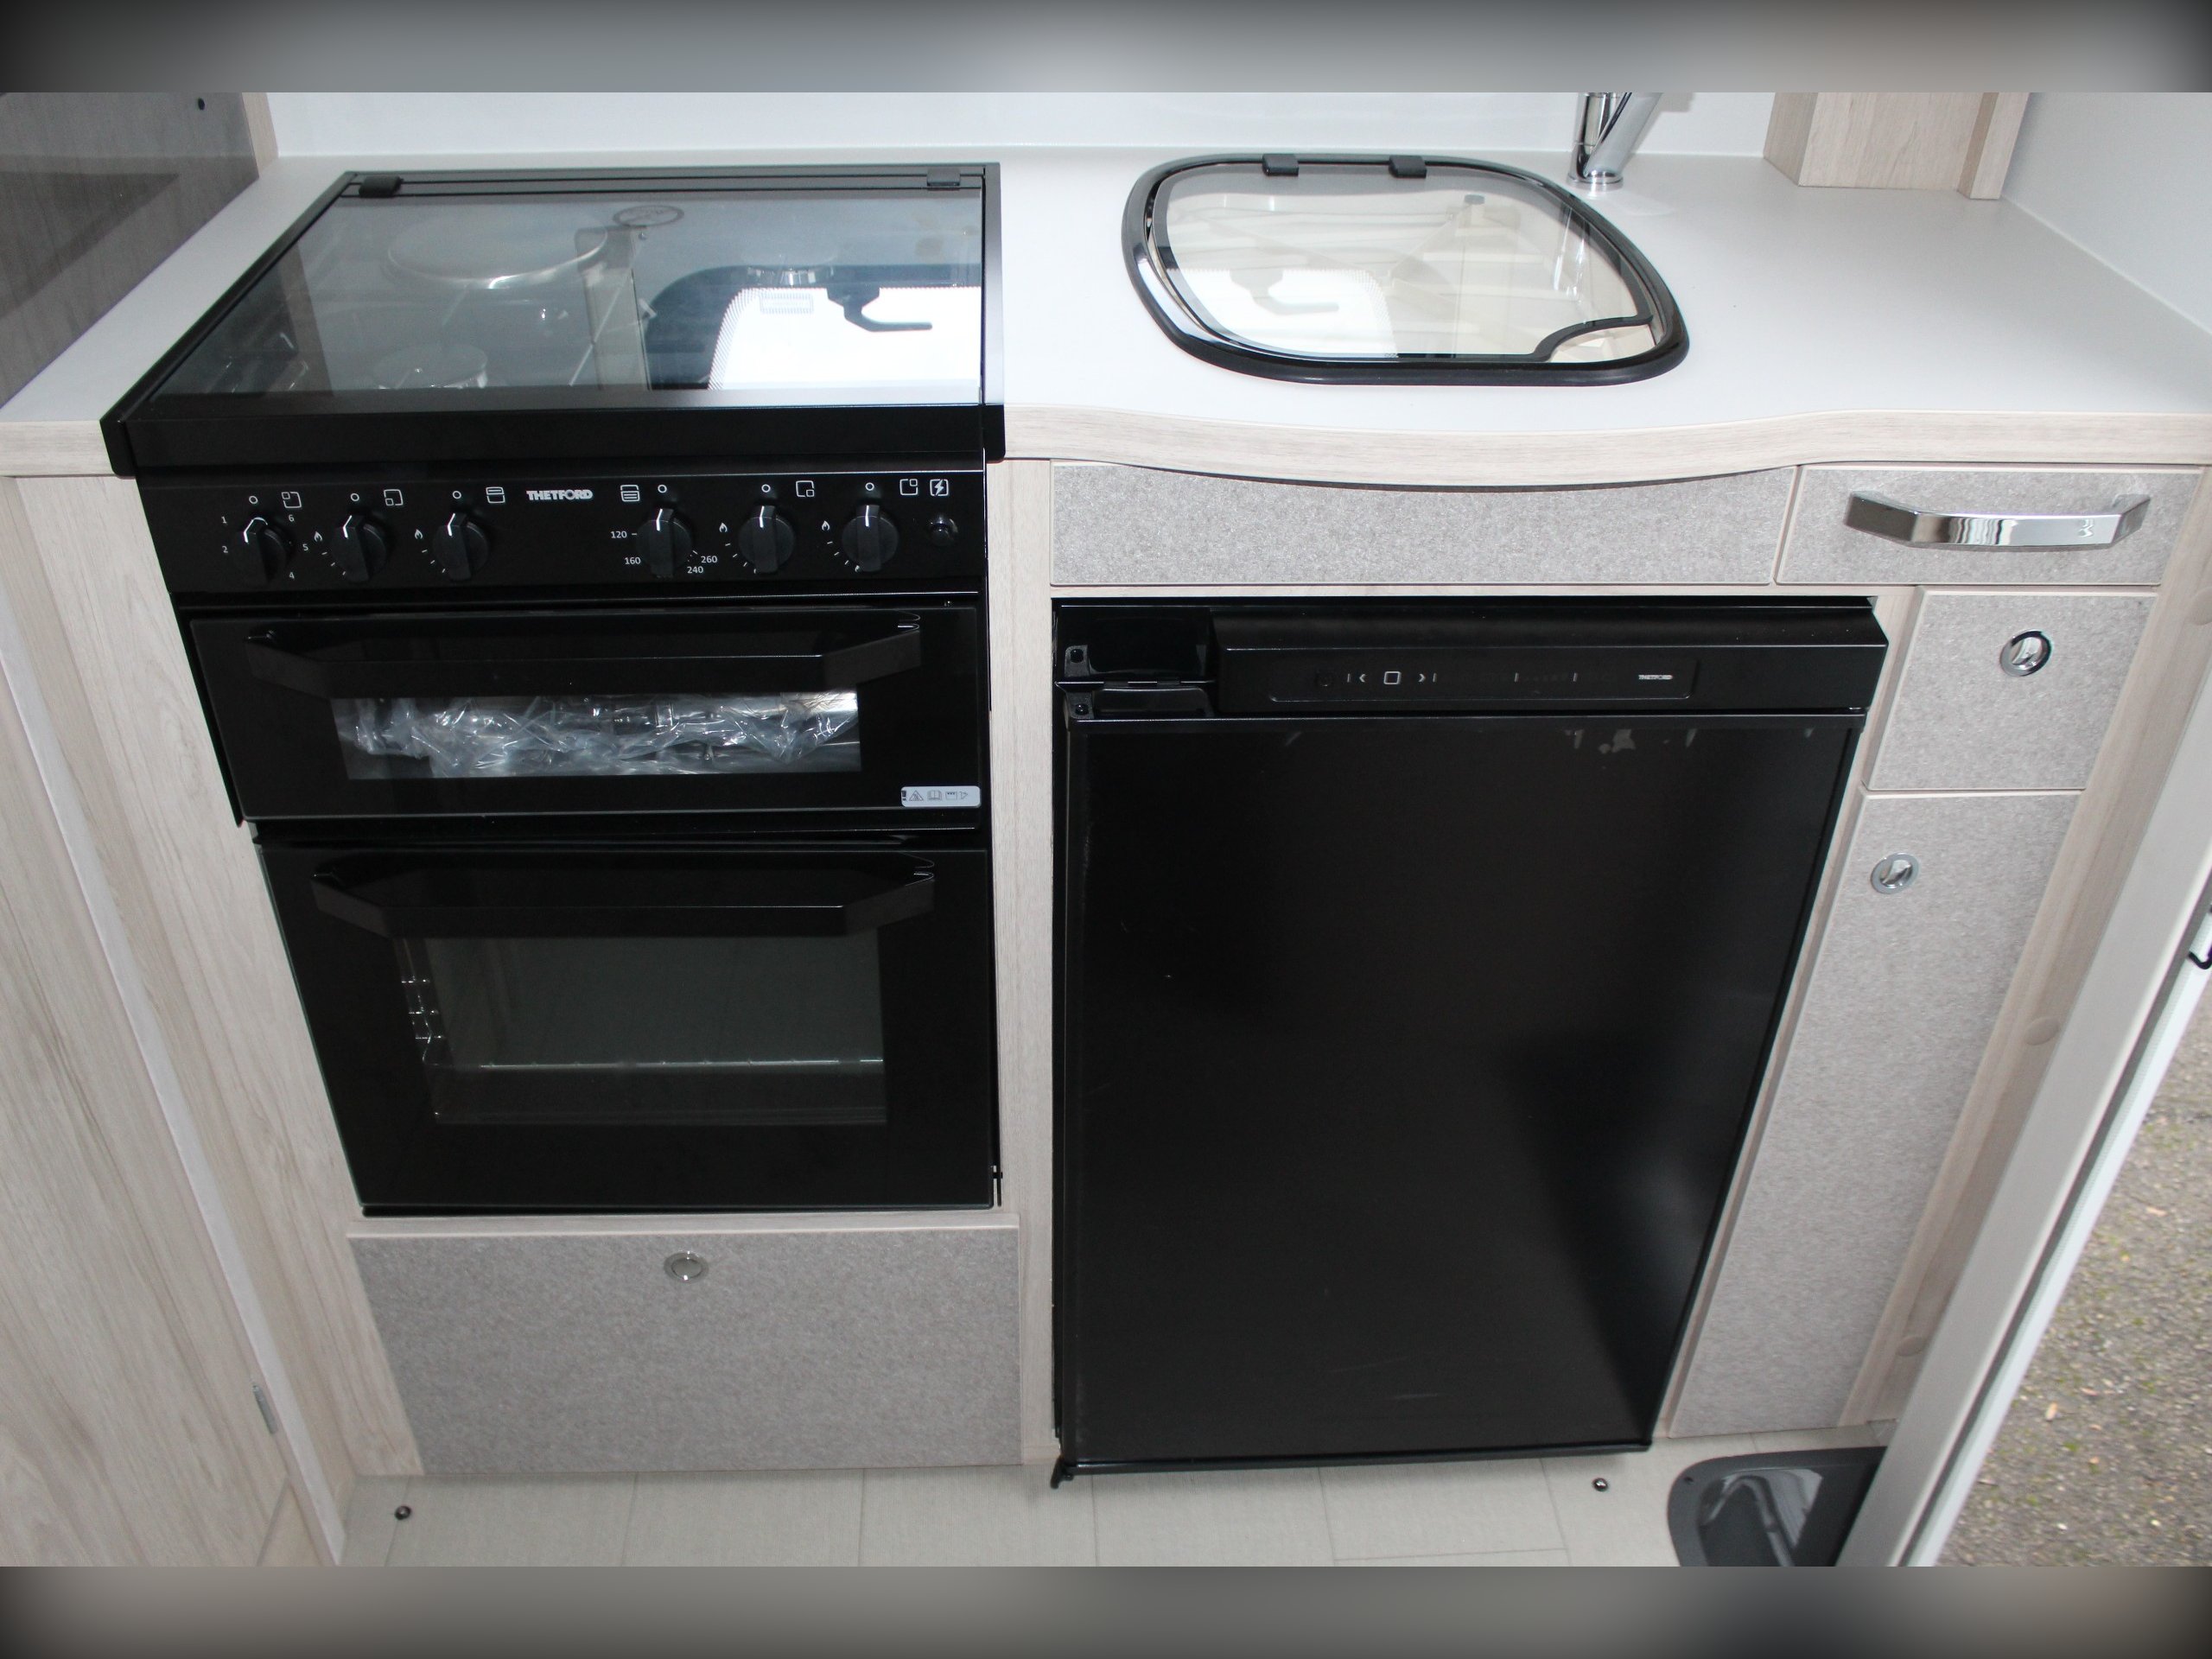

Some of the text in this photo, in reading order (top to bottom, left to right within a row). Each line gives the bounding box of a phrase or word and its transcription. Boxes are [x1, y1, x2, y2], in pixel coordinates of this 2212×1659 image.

[525, 489, 594, 501] THETFORD
[220, 516, 228, 524] 1
[288, 514, 296, 523] 6
[610, 531, 628, 539] 120
[221, 545, 229, 554] 2
[302, 543, 309, 552] 5
[624, 556, 642, 566] 160
[700, 555, 718, 564] 260
[686, 565, 705, 575] 240
[288, 571, 296, 580] 4
